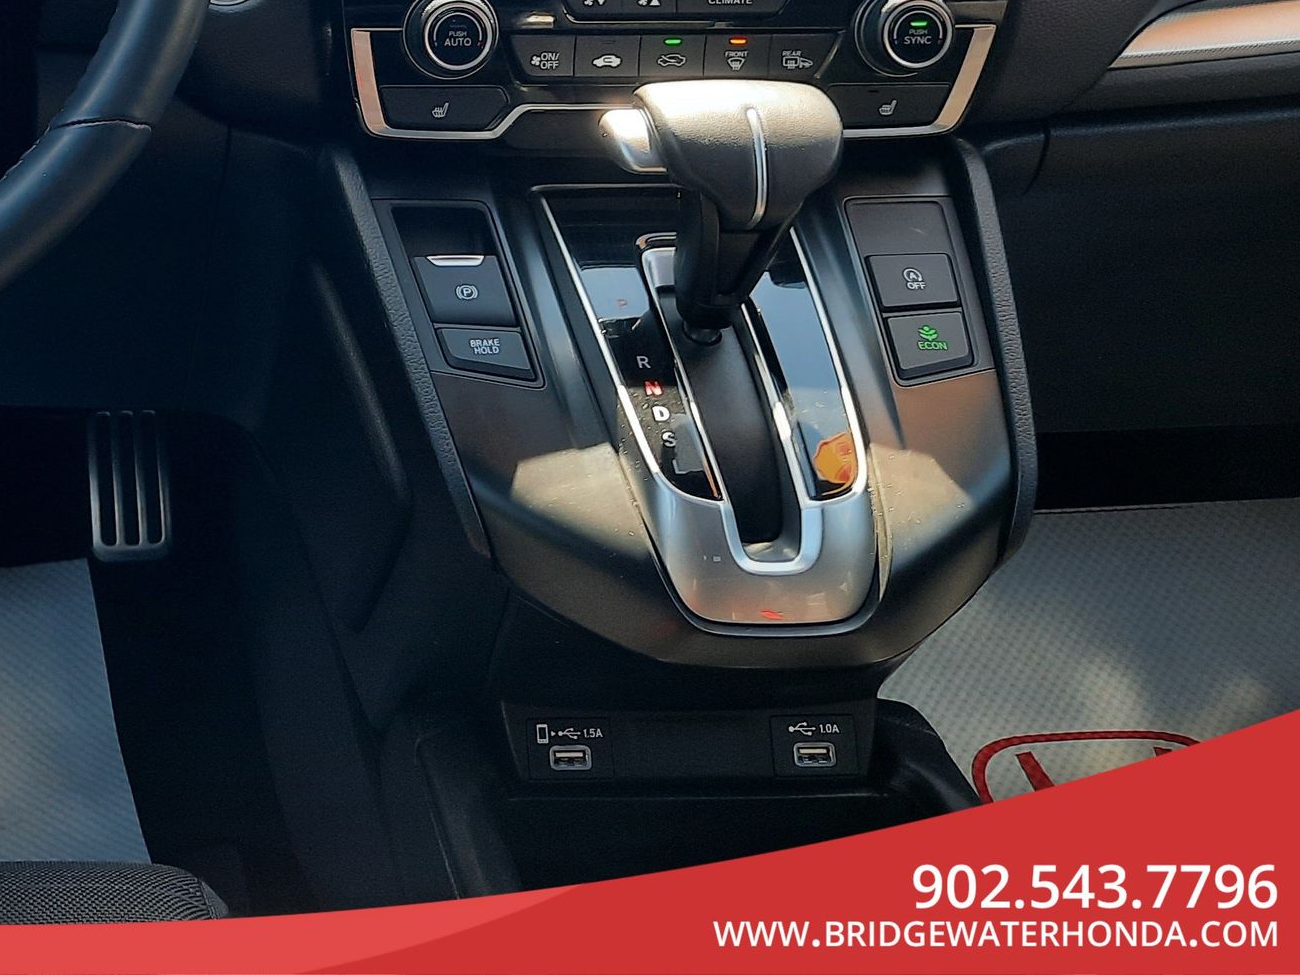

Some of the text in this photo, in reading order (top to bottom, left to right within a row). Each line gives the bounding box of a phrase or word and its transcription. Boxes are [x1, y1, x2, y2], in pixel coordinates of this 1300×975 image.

[444, 37, 472, 47] AUTO
[904, 35, 932, 45] SYNC
[541, 52, 560, 62] ON/
[540, 61, 559, 70] OFF
[907, 282, 926, 290] OFF
[470, 338, 500, 347] BRAKE
[917, 341, 948, 350] ECON
[474, 346, 500, 355] HOLD
[636, 356, 651, 369] R
[644, 381, 663, 396] N
[652, 406, 670, 422] D
[661, 431, 677, 447] S
[582, 728, 603, 739] 1.5A
[819, 723, 840, 734] 1.0A
